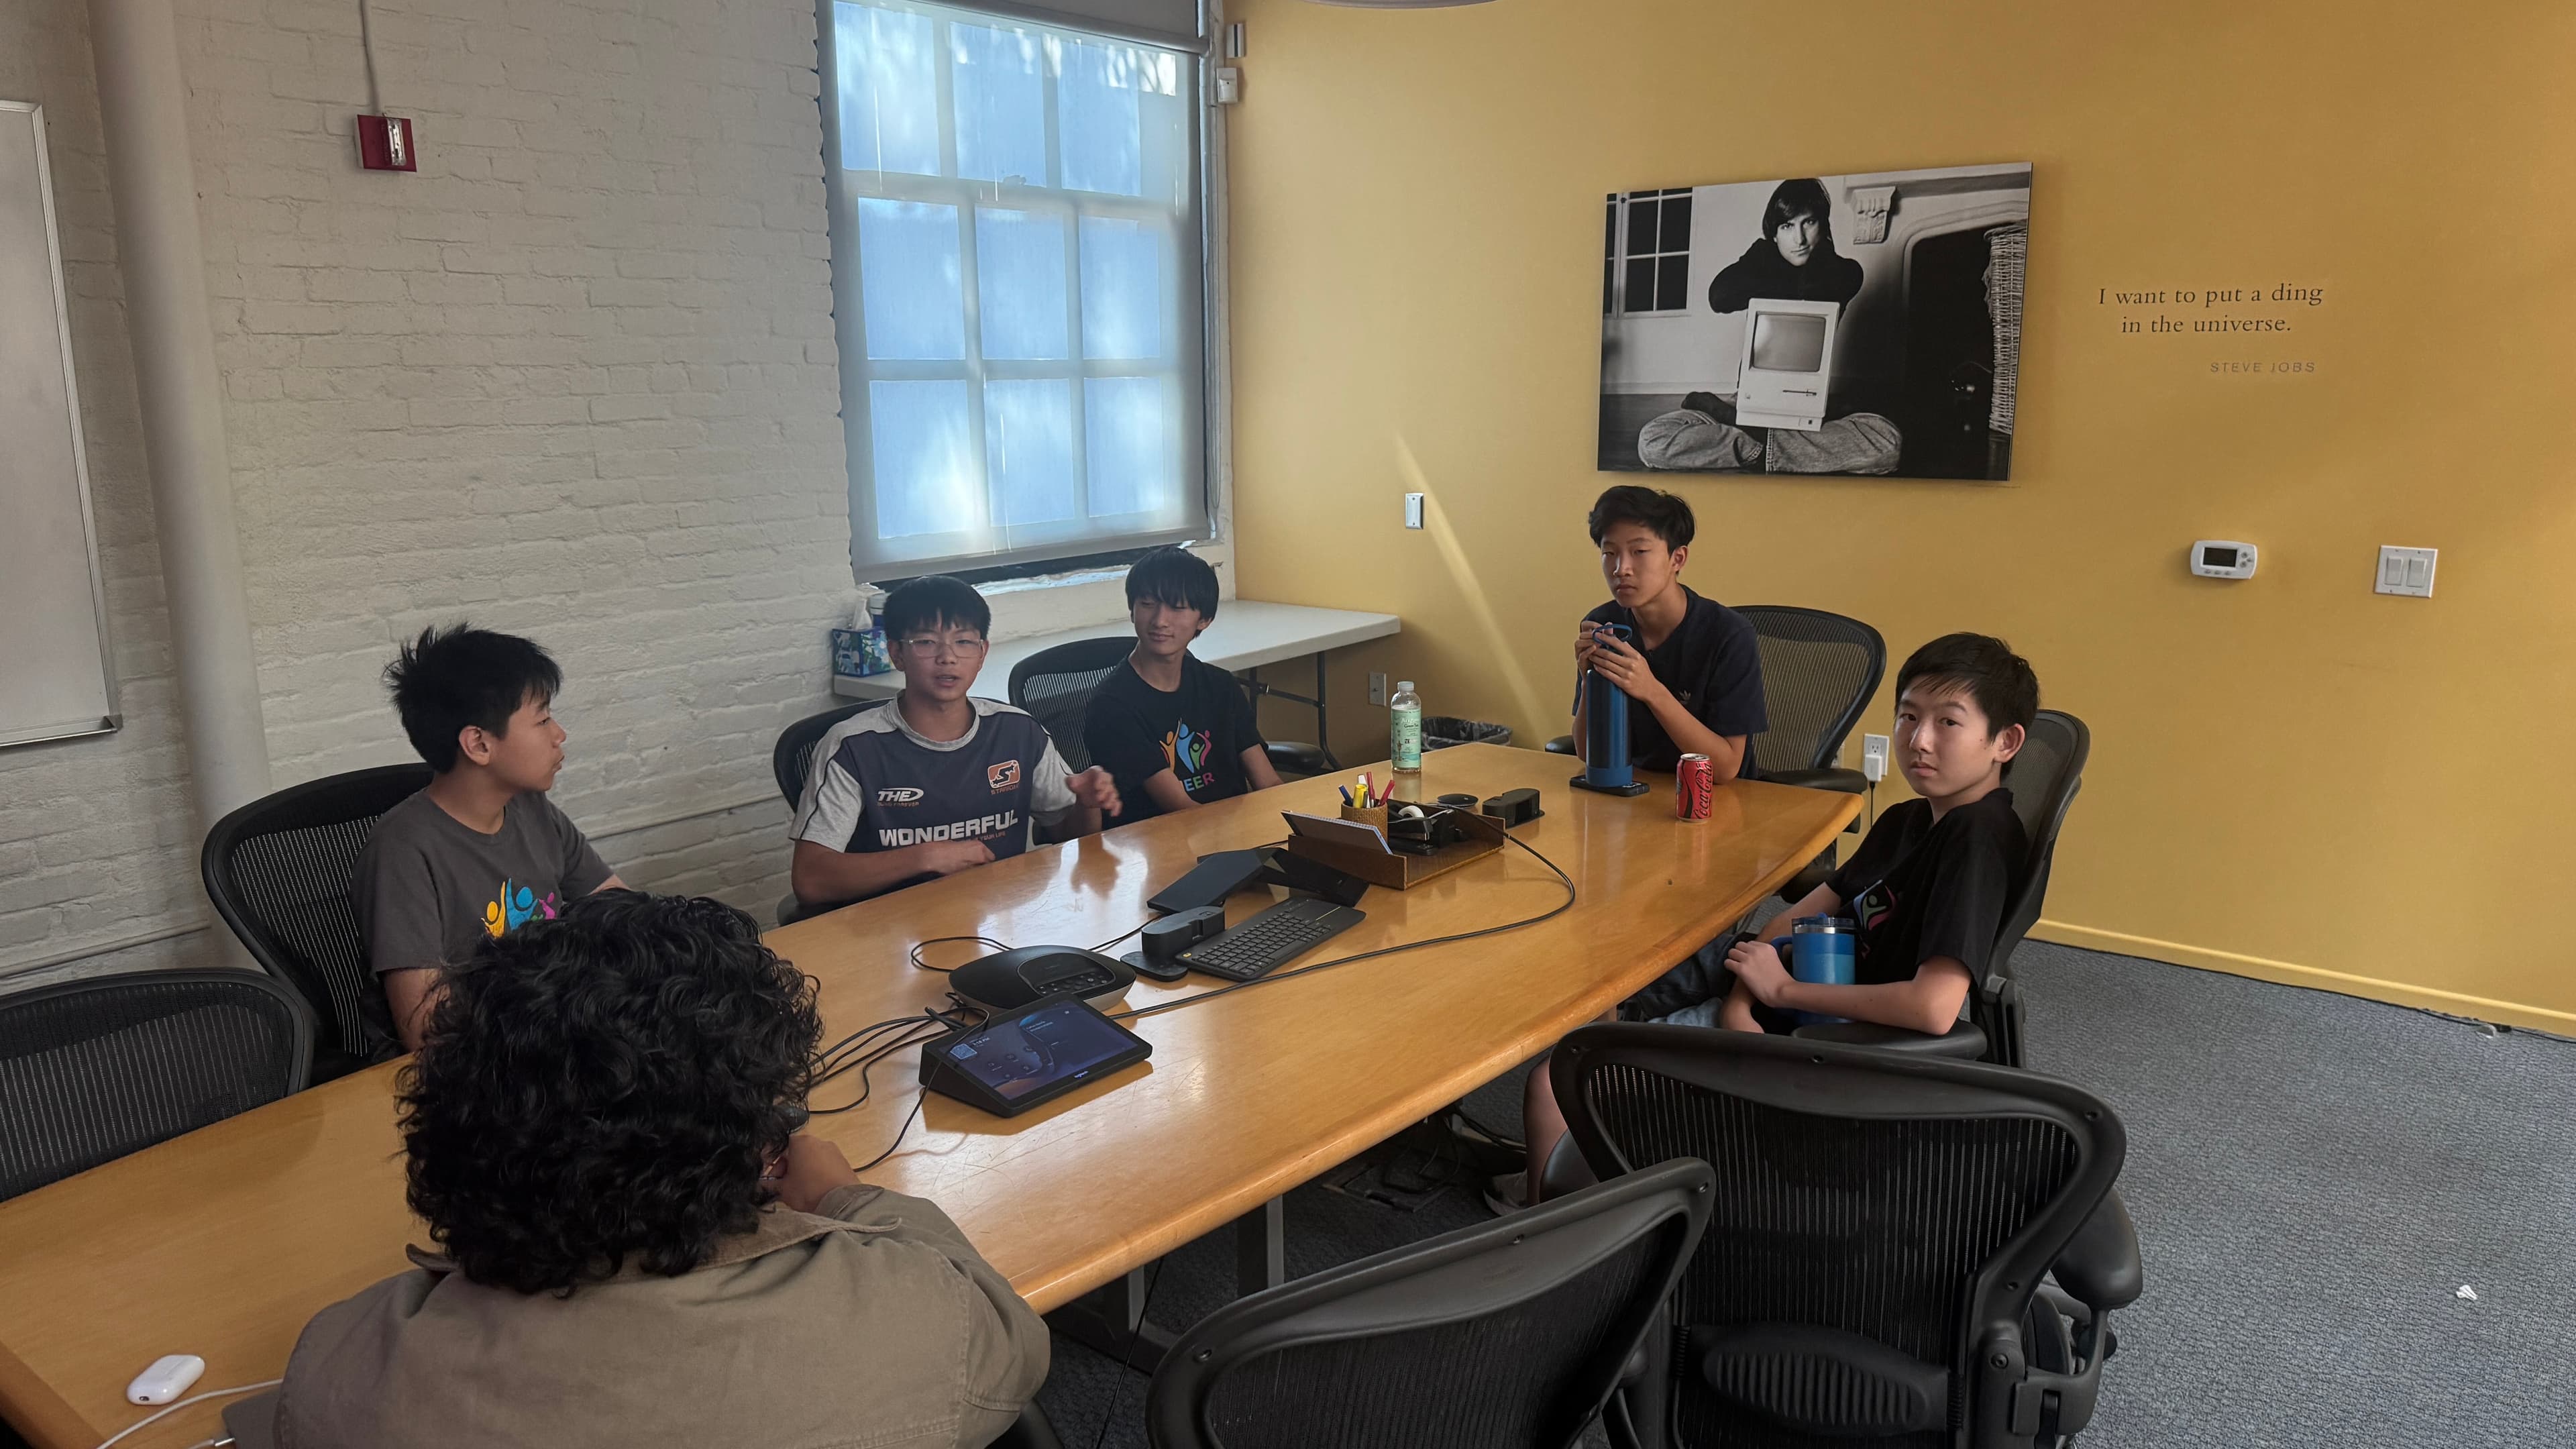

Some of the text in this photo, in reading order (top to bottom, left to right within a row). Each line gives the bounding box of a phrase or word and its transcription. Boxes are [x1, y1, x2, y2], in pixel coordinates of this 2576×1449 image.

[2099, 282, 2324, 309] I want to put a ding
[2121, 314, 2292, 333] in the universe.
[2210, 362, 2316, 374] STEVE JOBS
[1183, 773, 1215, 792] EER
[877, 789, 918, 802] THE
[879, 810, 1018, 847] WONDERFUL
